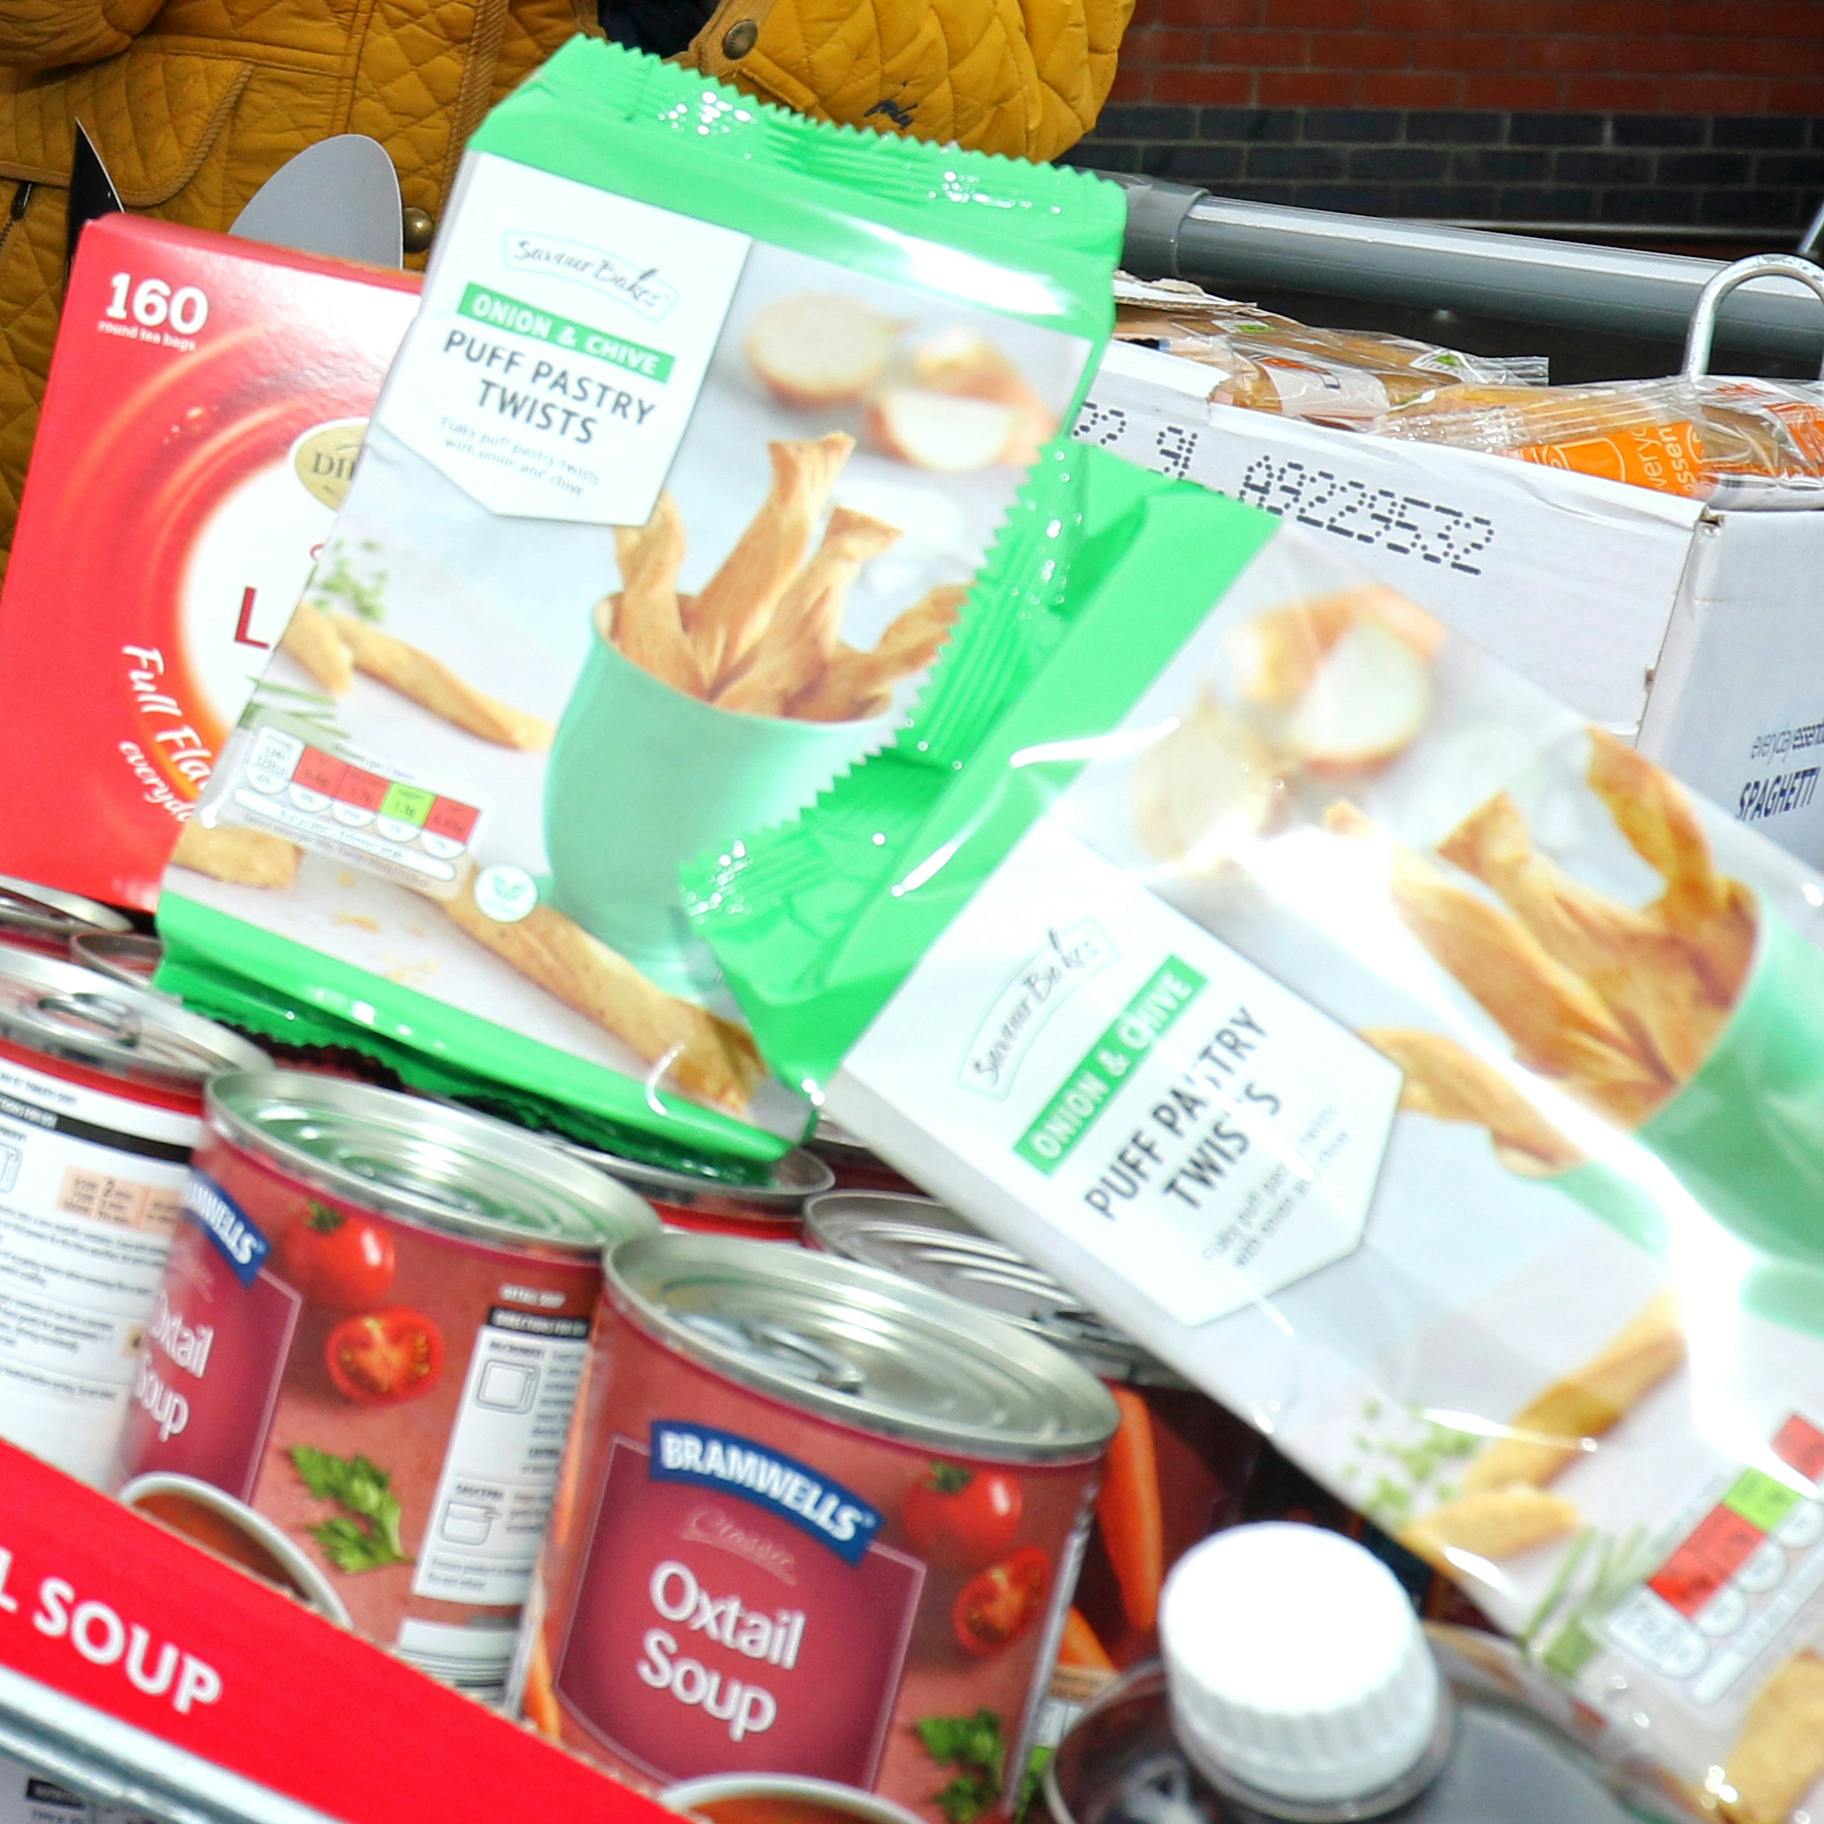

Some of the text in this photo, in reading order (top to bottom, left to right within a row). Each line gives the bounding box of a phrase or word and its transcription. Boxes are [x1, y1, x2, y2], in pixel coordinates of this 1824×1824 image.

[97, 320, 197, 353] round tea bags
[105, 271, 210, 336] 160
[472, 293, 660, 376] ONION & CHIVE
[444, 329, 656, 426] PUFF PASTRY
[478, 378, 597, 445] TWISTS
[512, 443, 555, 466] pastry
[559, 459, 601, 486] twists
[121, 644, 183, 718] Full
[1736, 766, 1821, 822] SPAGHETTI
[1029, 971, 1195, 1161] ONION & CHIVE
[1083, 1128, 1163, 1222] PUFF
[1162, 1080, 1283, 1211] TWISS
[658, 1432, 868, 1544] BRAMWELLS
[682, 1509, 797, 1585] Classic
[31, 1578, 223, 1715] SOUP
[647, 1559, 806, 1671] Oxtail
[637, 1629, 777, 1742] Soup
